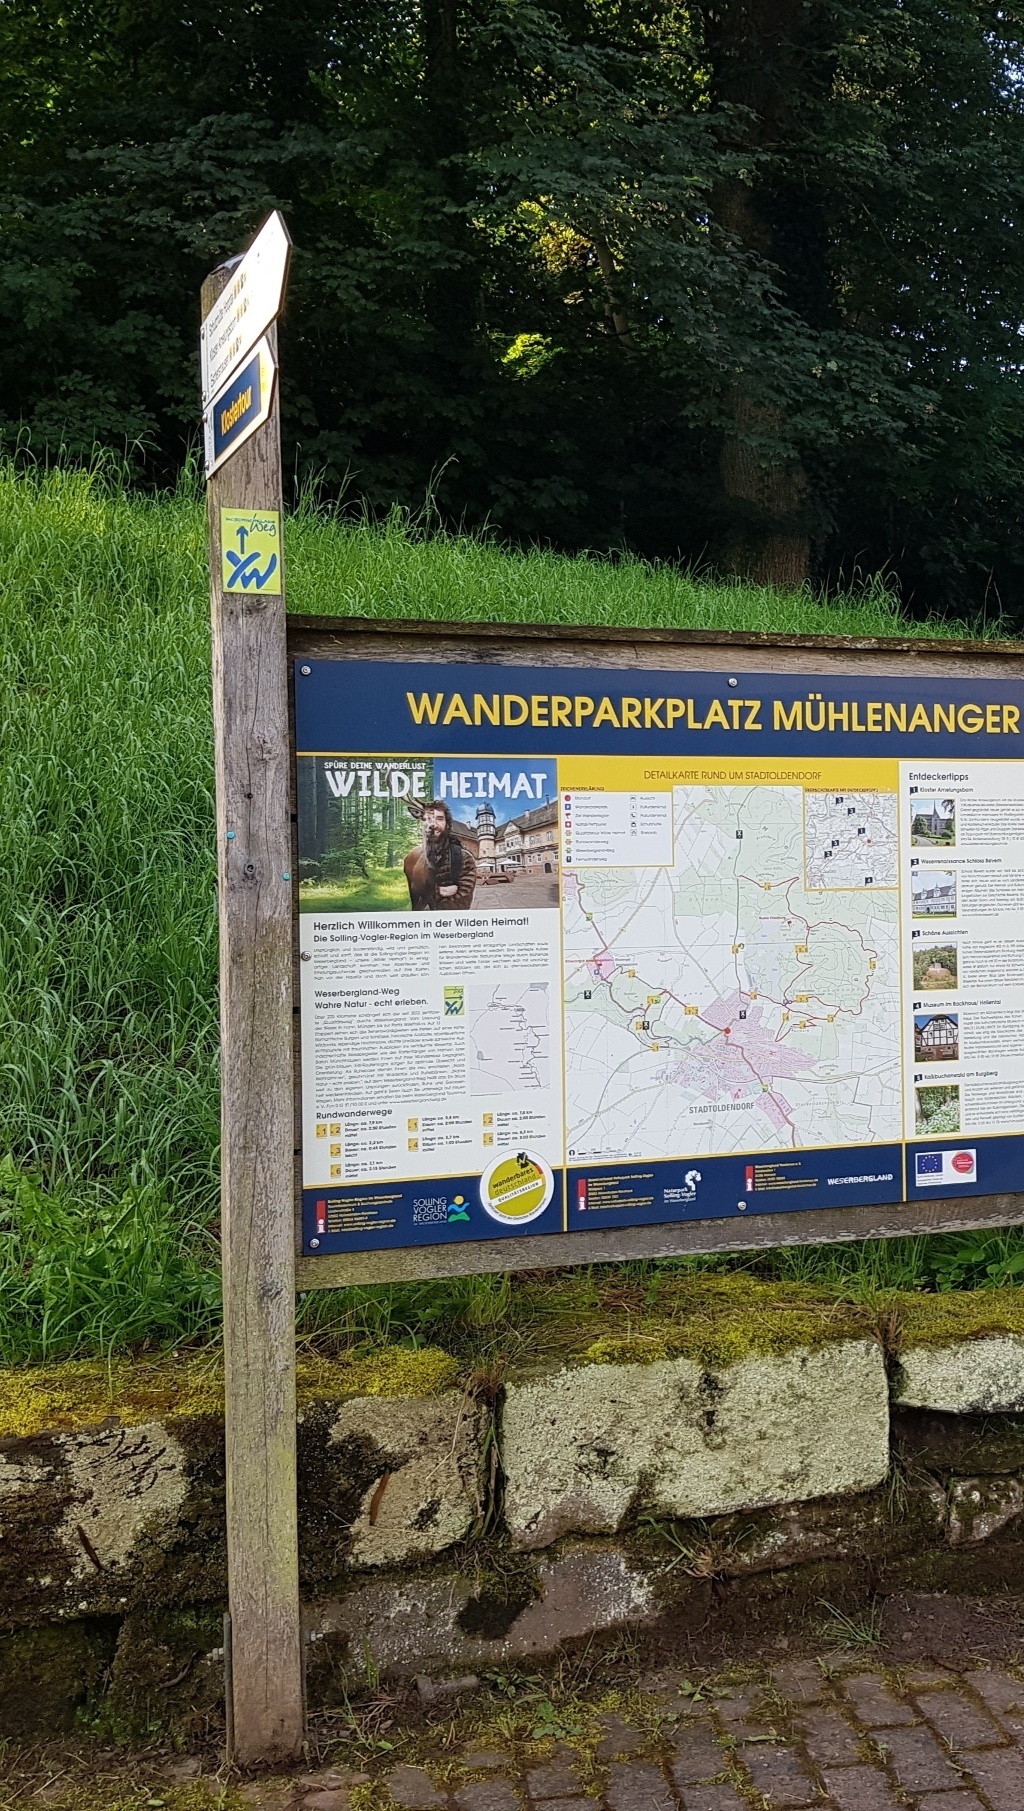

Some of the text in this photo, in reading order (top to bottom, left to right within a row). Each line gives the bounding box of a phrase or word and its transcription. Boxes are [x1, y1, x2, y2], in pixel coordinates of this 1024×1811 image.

[221, 385, 252, 437] Klostertour
[406, 692, 1020, 734] WANDERPARKPLATZ MÜHLENANGER
[324, 760, 348, 769] SPÜRE
[644, 771, 822, 780] DETAILKARTE RUND UM STADTOLDENDORF
[909, 772, 969, 782] Entdeckertipps
[324, 770, 548, 799] WILDE HEIMAT
[314, 917, 529, 930] Herzlich Willkommen in der Wilden Heimat!
[330, 933, 418, 943] Solling-Vogler-Region
[433, 931, 494, 939] Weserbergland
[314, 988, 400, 997] Weserbergland-Weg
[316, 1109, 393, 1119] Rundwanderwege
[689, 1102, 755, 1114] STADTOLDENDORF
[493, 1167, 534, 1188] wanderbares
[827, 1173, 894, 1185] WESERBERGLAND
[495, 1173, 536, 1195] deutschland
[413, 1205, 446, 1214] VOGLER
[413, 1212, 447, 1222] REGION
